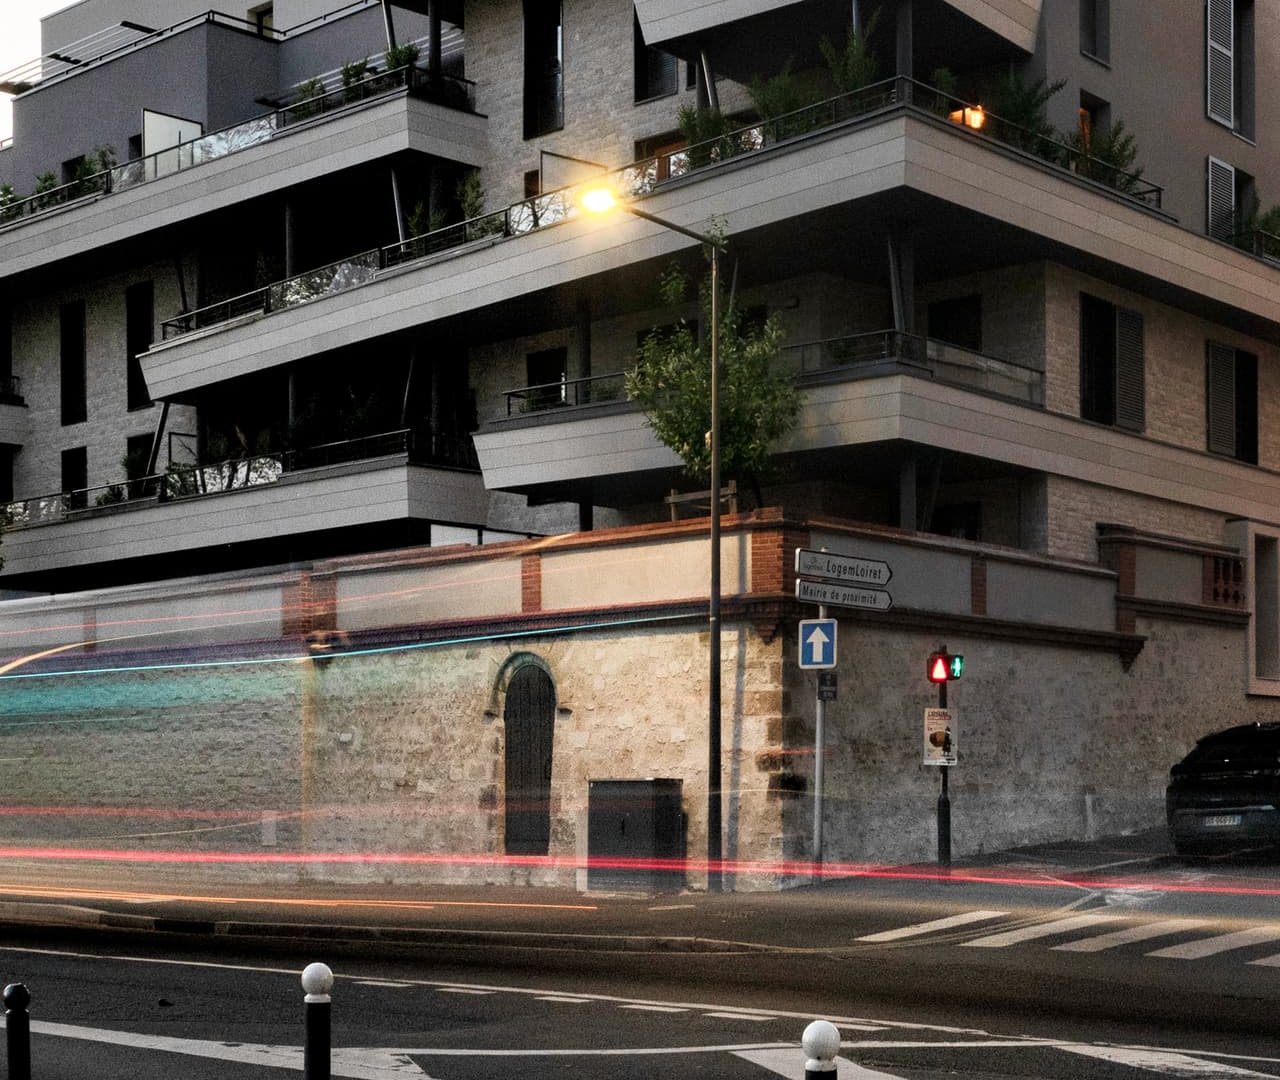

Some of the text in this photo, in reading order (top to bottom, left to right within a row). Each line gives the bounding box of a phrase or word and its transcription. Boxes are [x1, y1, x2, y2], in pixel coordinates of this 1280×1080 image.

[826, 560, 881, 579] LogemLoiret
[802, 585, 877, 605] Mairie de proximité
